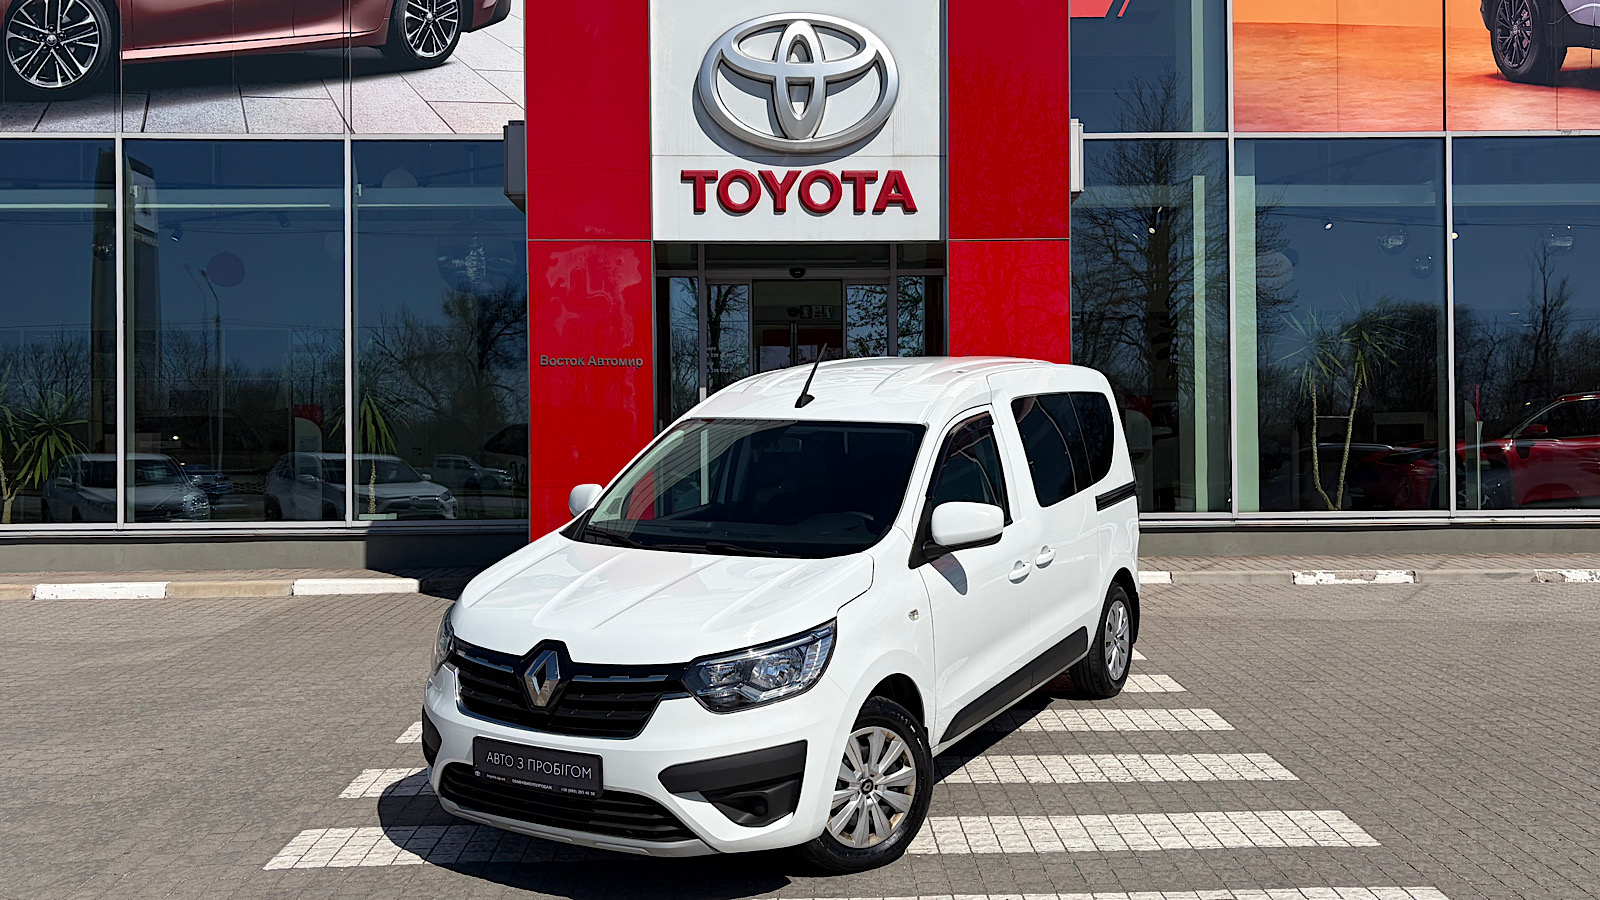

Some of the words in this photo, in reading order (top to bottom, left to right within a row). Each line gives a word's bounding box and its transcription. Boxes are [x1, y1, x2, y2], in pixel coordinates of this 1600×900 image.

[680, 169, 918, 215] TOYOTA
[540, 355, 585, 367] Восток
[588, 355, 644, 370] Автомир
[486, 752, 514, 768] АВТО
[527, 759, 592, 780] ПРОБІГОМ
